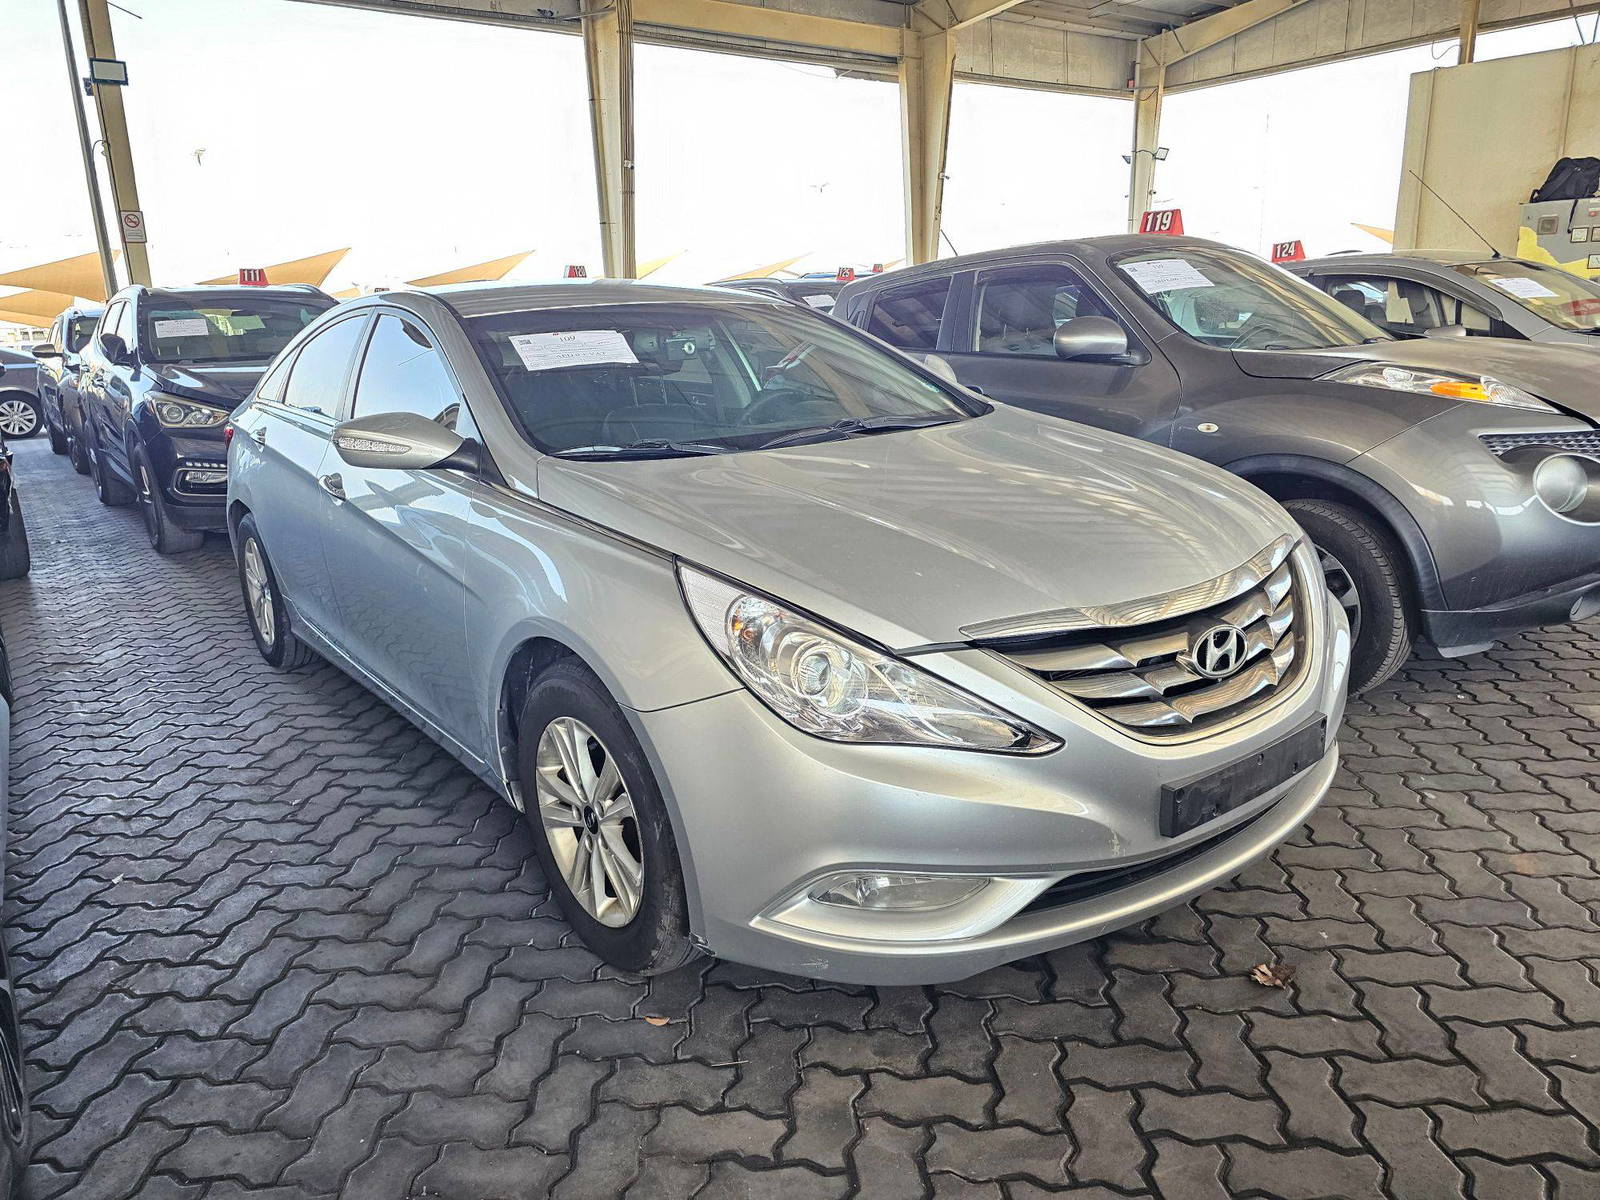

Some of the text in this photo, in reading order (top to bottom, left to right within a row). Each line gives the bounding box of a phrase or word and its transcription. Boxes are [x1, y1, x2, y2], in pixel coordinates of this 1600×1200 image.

[1145, 211, 1173, 232] 119
[1275, 242, 1296, 258] 124
[243, 269, 261, 281] 111
